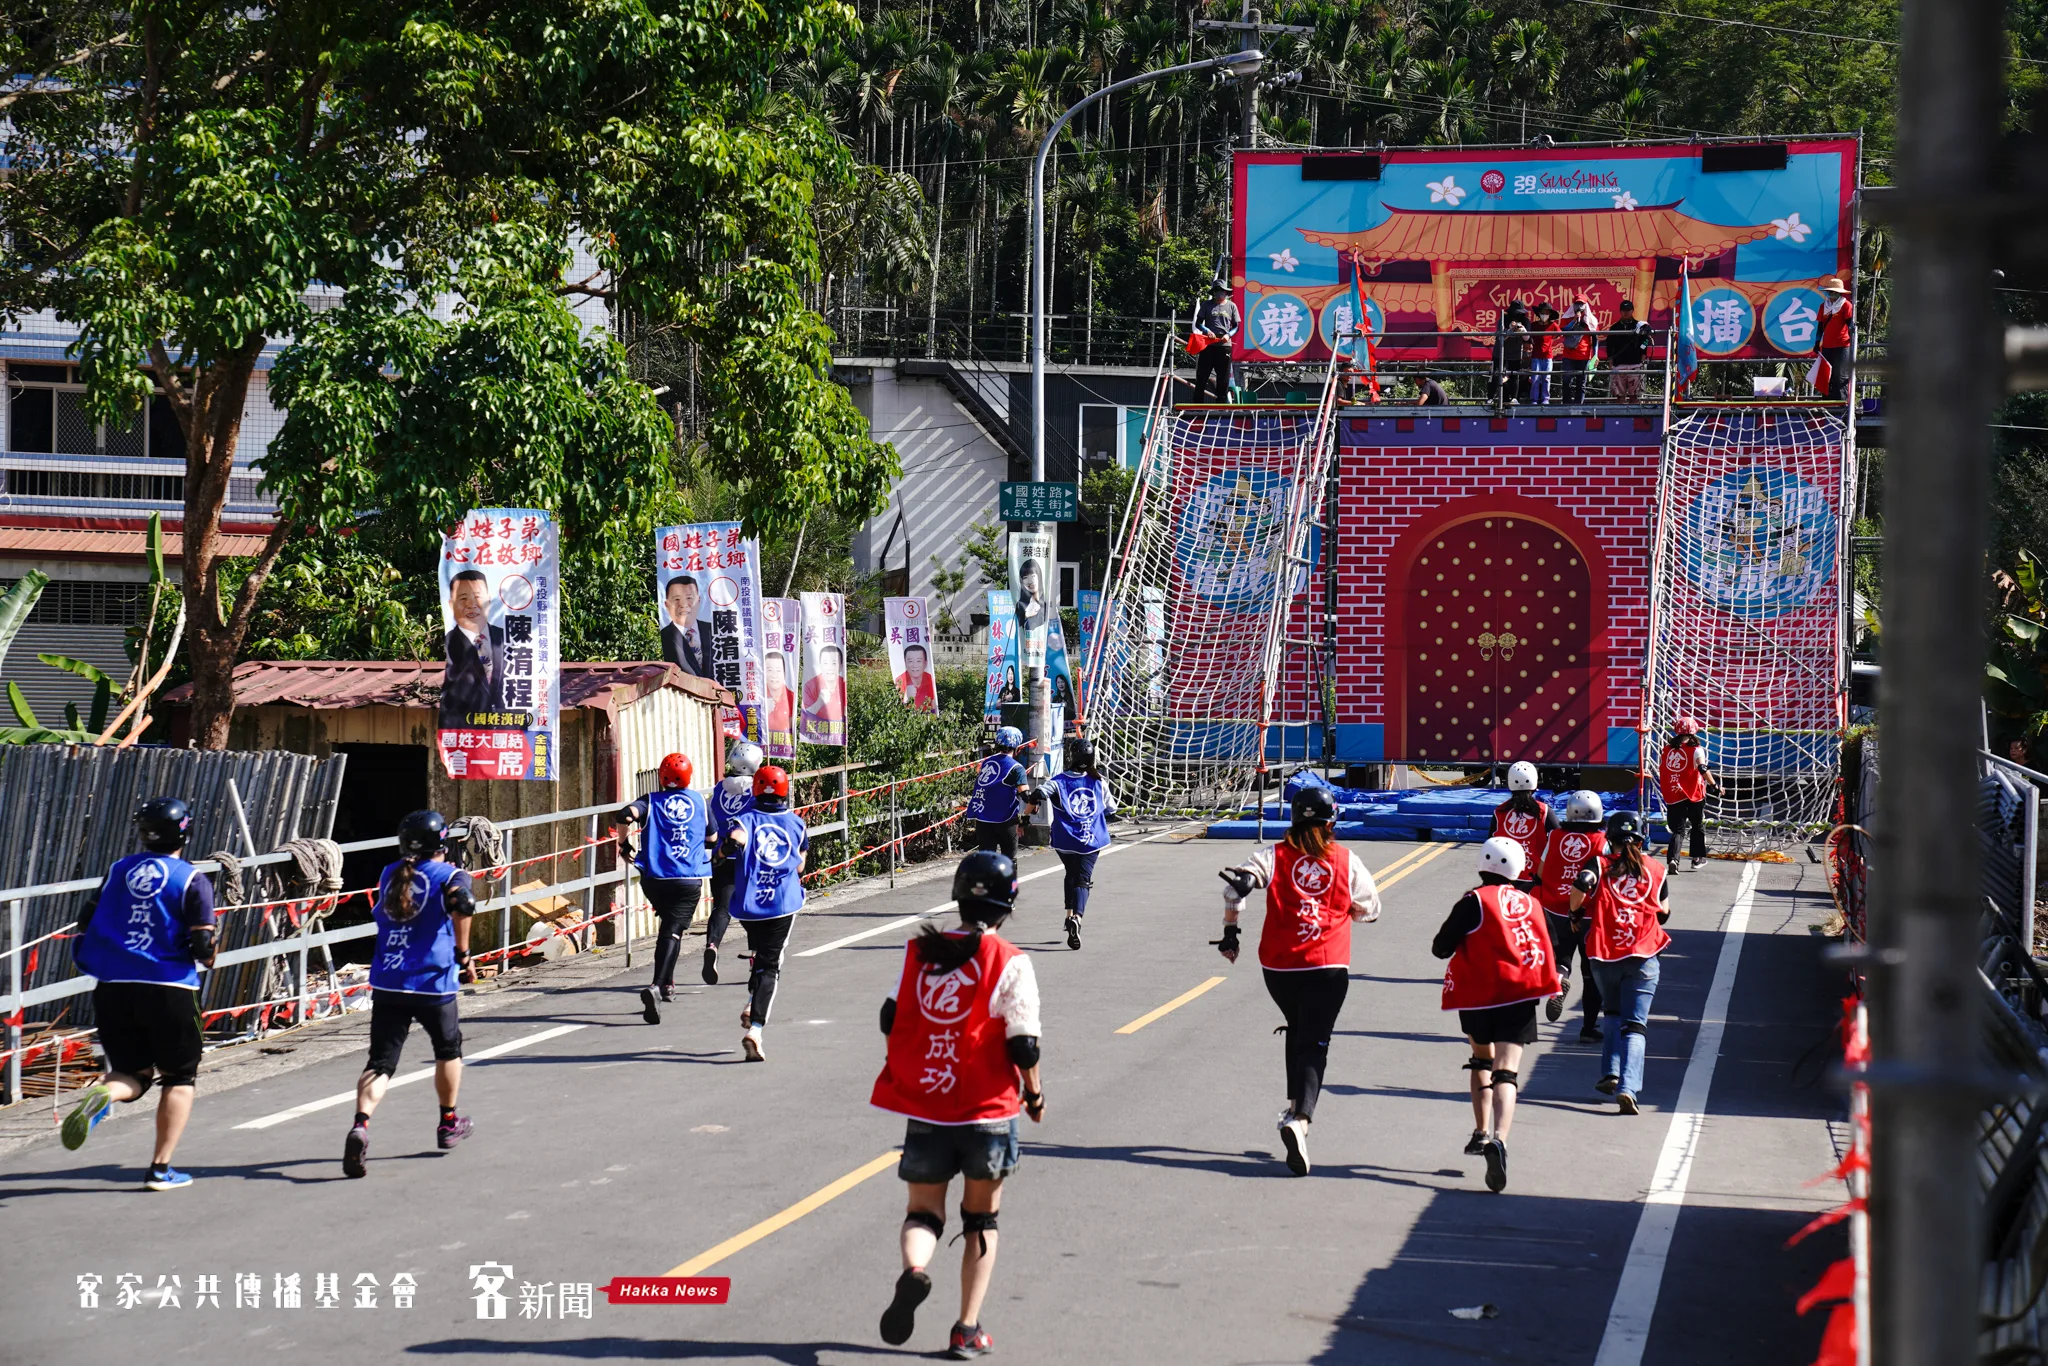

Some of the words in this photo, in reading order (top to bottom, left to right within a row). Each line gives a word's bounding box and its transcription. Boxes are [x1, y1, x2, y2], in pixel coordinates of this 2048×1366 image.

[1598, 186, 1621, 194] GONG
[1016, 485, 1062, 499] 國姓路
[1015, 498, 1062, 510] 民生街
[663, 528, 742, 552] 國姓子弟
[446, 542, 543, 567] 心在故鄉
[663, 550, 747, 572] 心在故鄉
[768, 606, 776, 618] 3
[823, 599, 833, 615] 3
[907, 604, 915, 615] 3
[441, 732, 524, 749] 國姓大團結
